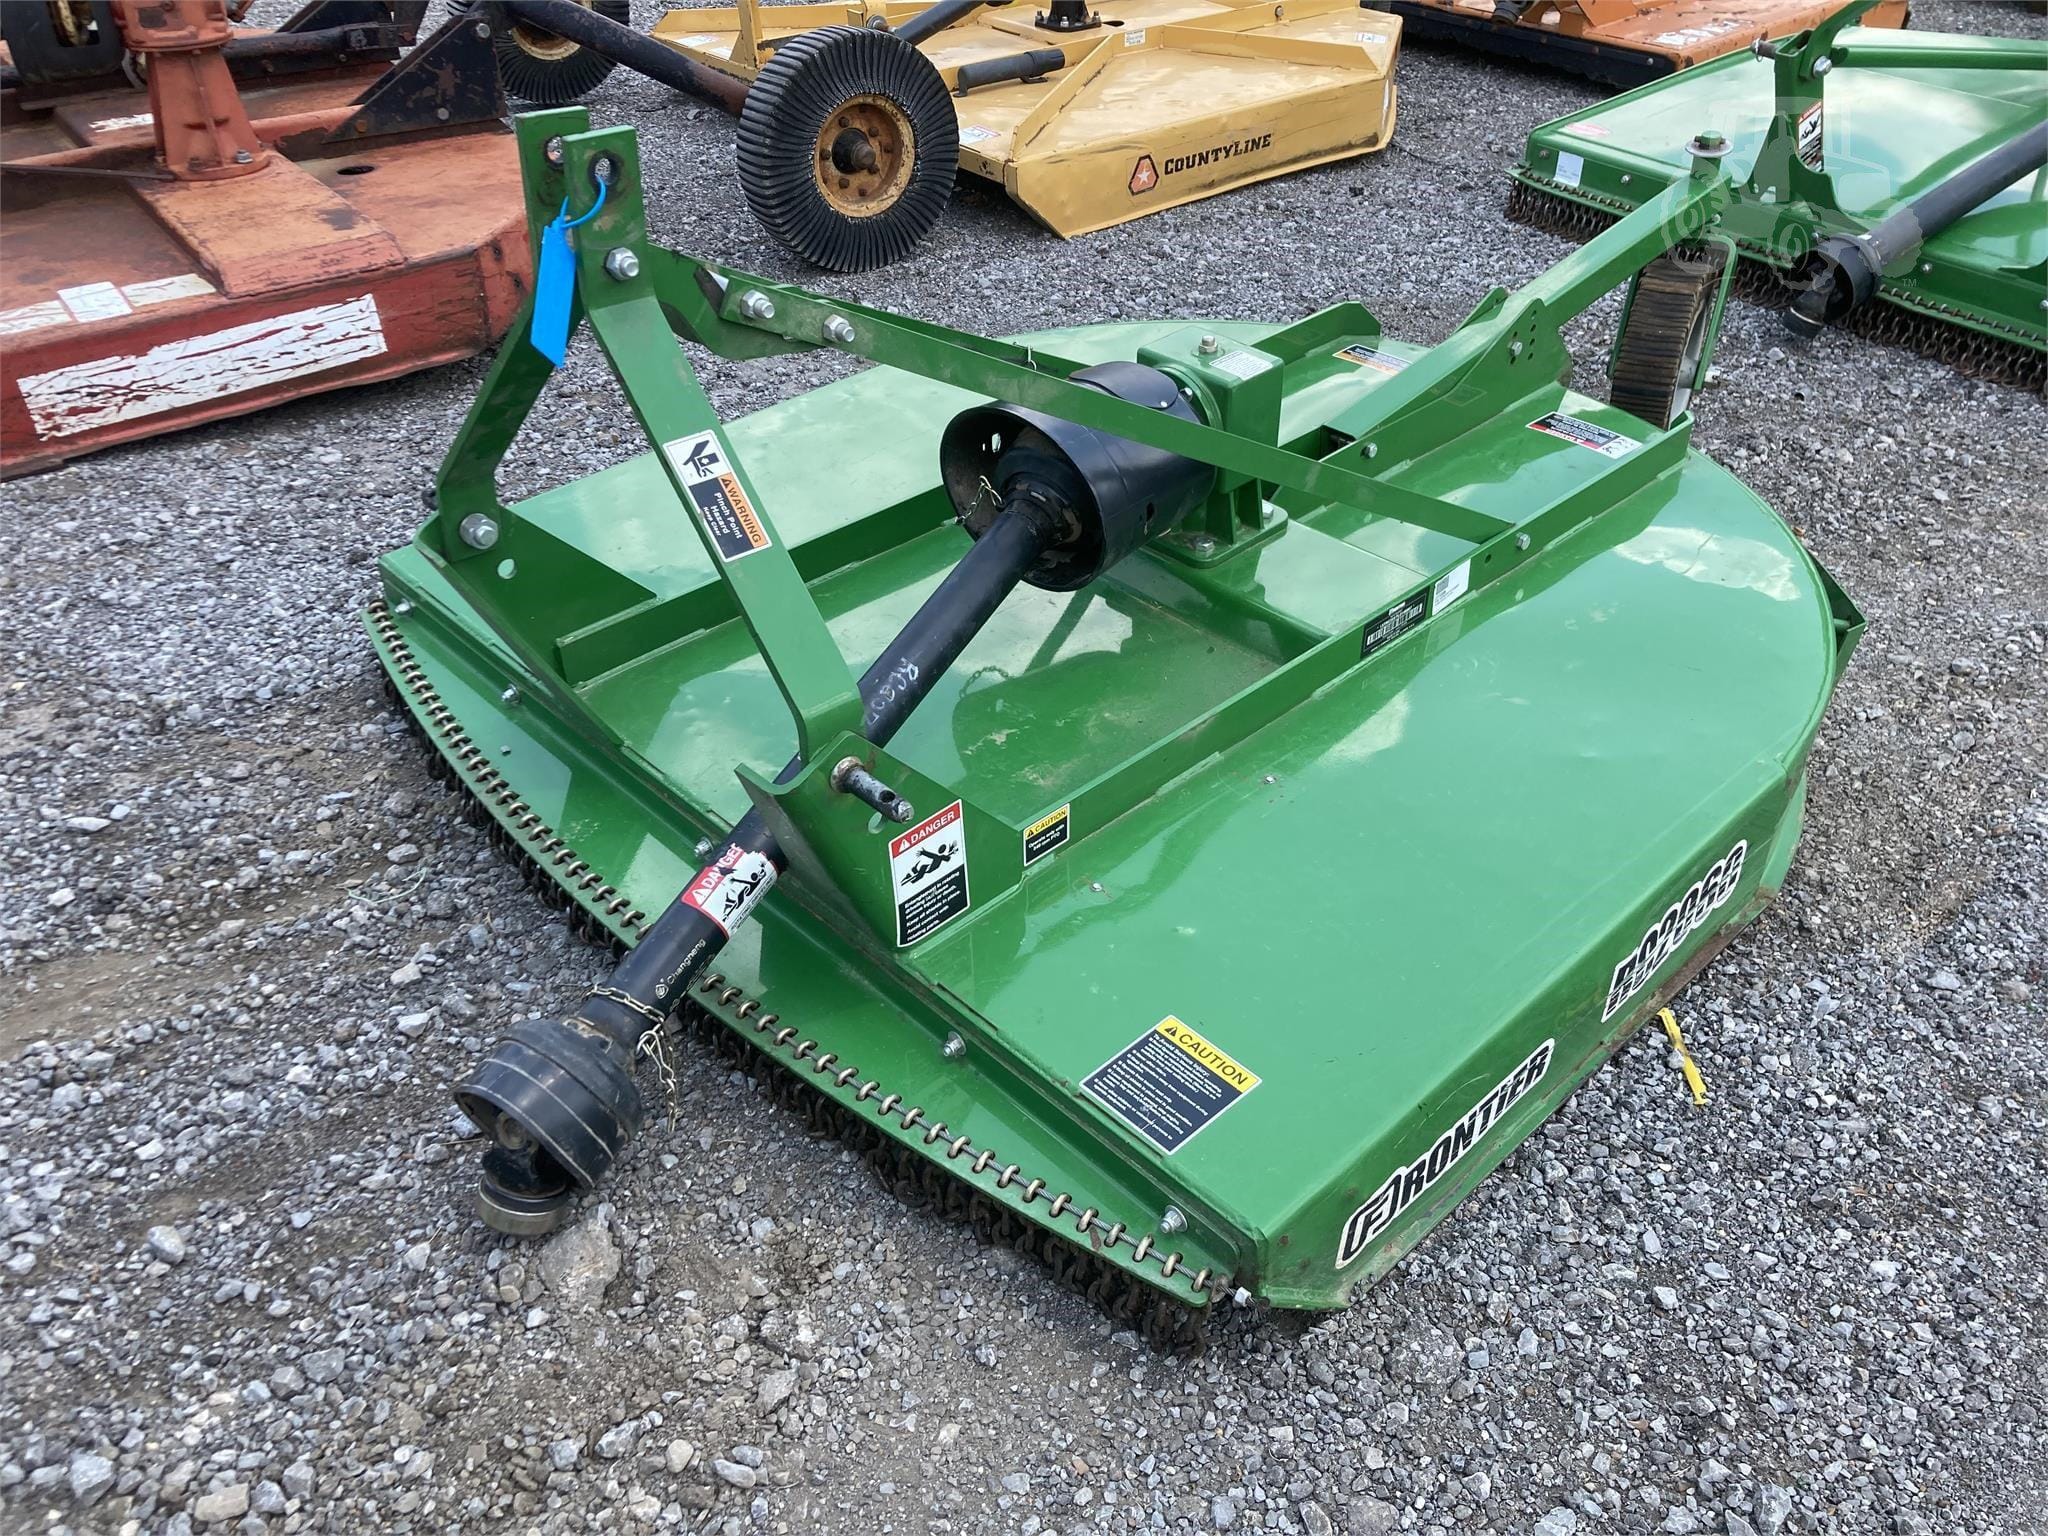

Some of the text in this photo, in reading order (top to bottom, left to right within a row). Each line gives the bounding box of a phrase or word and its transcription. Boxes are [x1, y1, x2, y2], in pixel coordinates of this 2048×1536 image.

[1165, 133, 1272, 175] COUNTYLINE
[702, 506, 722, 537] Keep Clear
[710, 504, 730, 534] Hazard
[713, 491, 743, 539] Pinch Point
[725, 486, 763, 543] WARNING
[910, 809, 955, 845] DANGER
[1034, 808, 1065, 832] CAUTION
[667, 938, 707, 985] Changneng
[1176, 1032, 1249, 1085] CAUTION
[1341, 1044, 1551, 1262] FRONTIER
